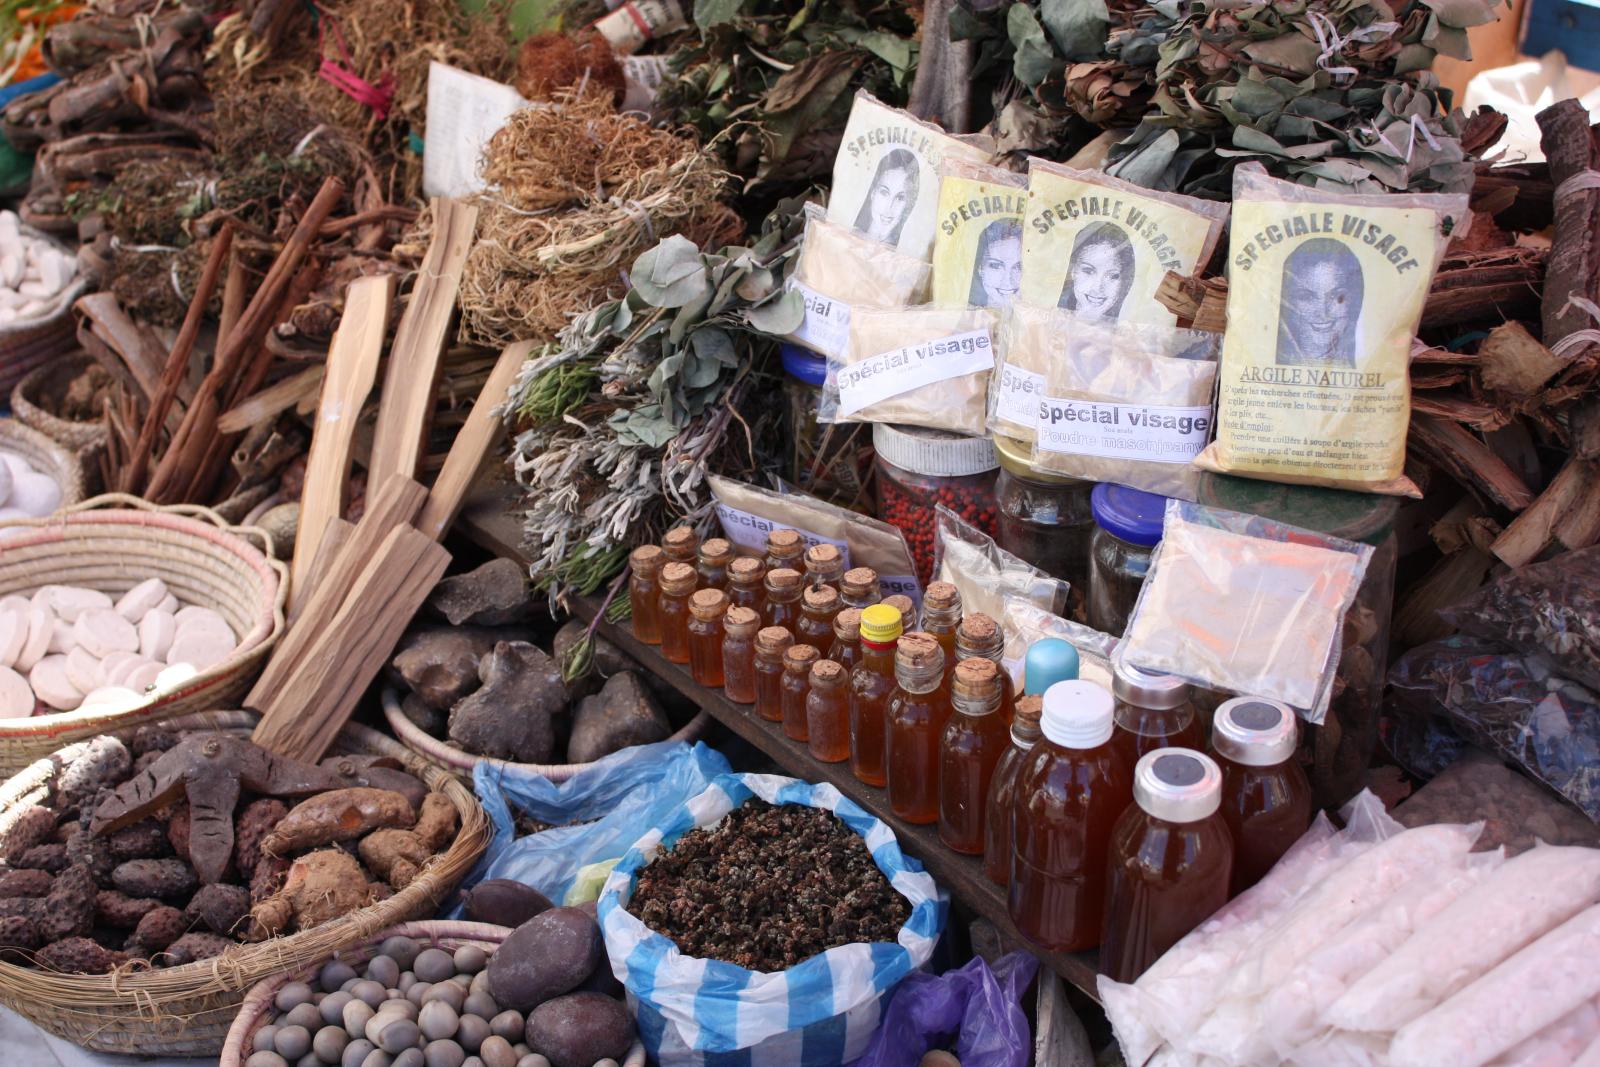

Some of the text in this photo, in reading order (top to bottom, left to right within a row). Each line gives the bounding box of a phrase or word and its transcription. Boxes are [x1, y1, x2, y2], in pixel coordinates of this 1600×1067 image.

[847, 126, 917, 158] SPECIALE
[941, 194, 1026, 236] SPECIALE
[1032, 196, 1182, 272] SPECIALE VISAGE
[1235, 212, 1419, 274] SPECIALE VISAGE
[839, 348, 909, 390] Spécial
[915, 335, 989, 361] visage
[1240, 366, 1385, 388] ARGILE NATUREL
[1040, 401, 1119, 425] Spécial
[1128, 409, 1209, 435] visage
[1041, 426, 1096, 446] Poudre
